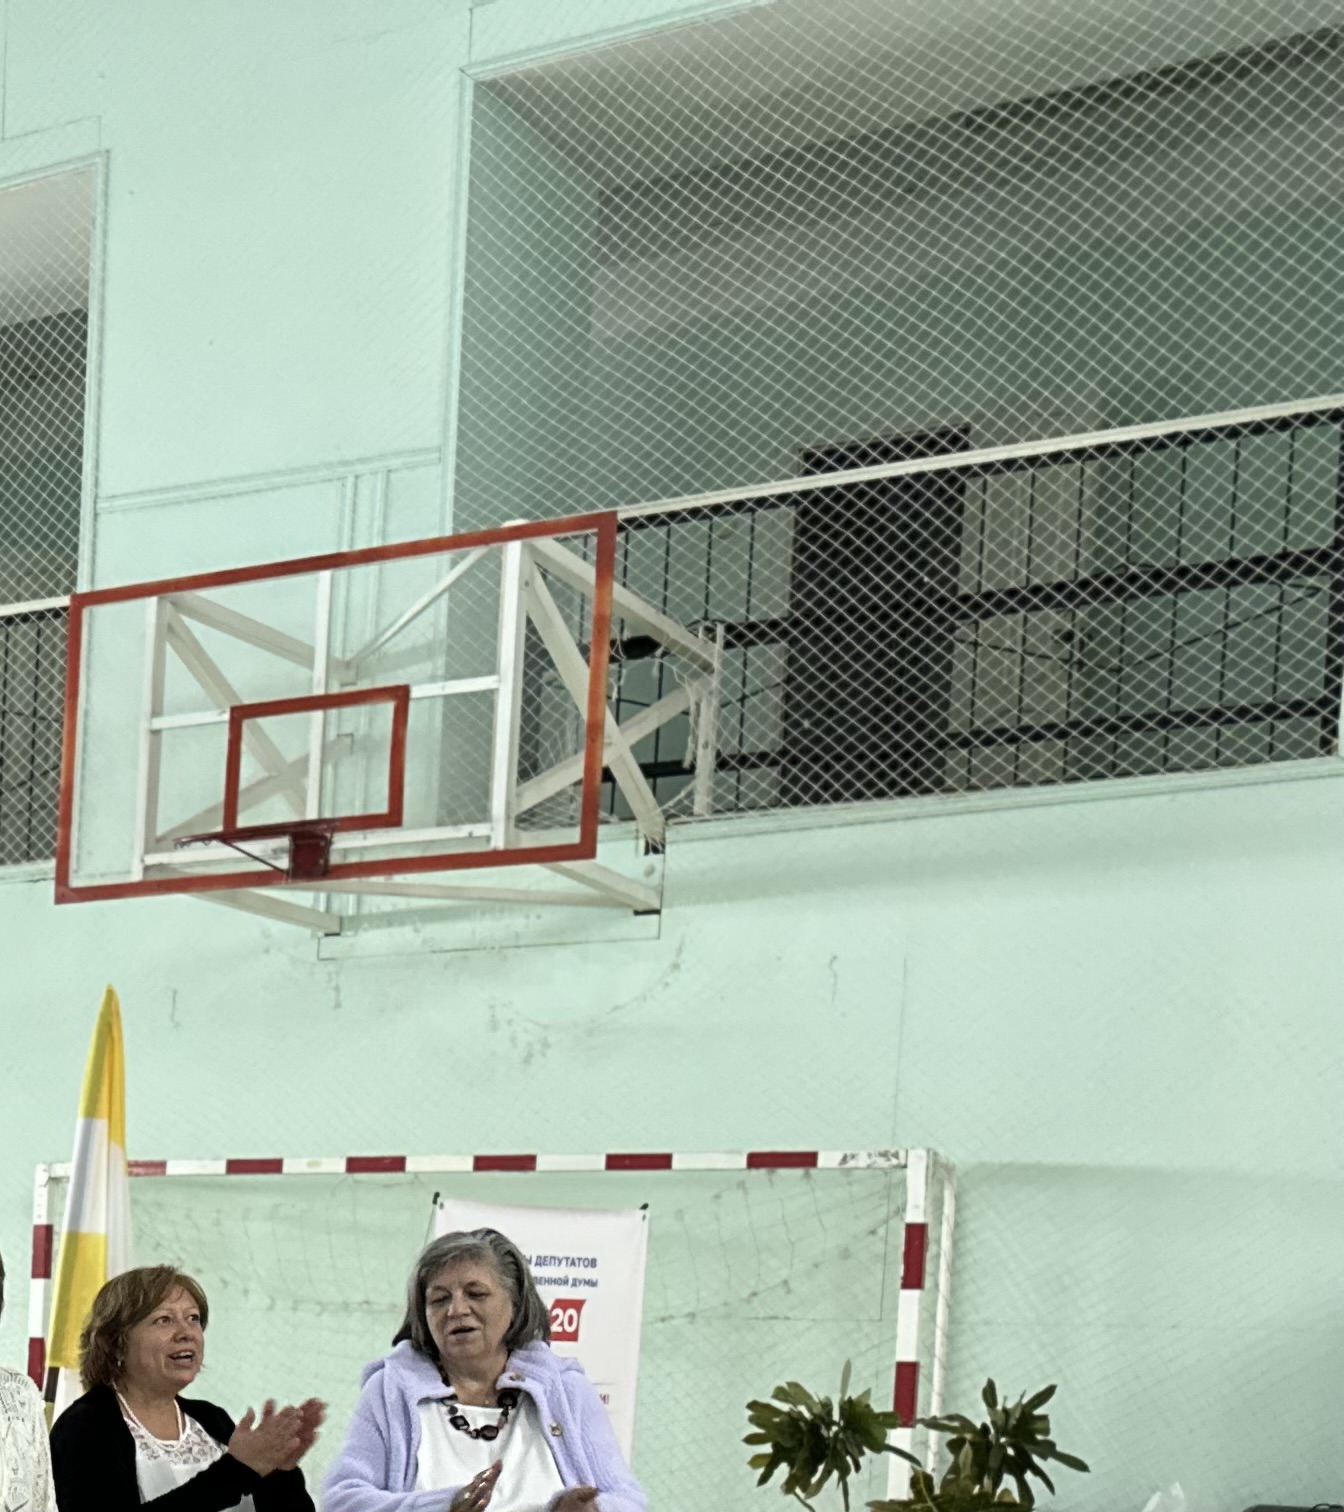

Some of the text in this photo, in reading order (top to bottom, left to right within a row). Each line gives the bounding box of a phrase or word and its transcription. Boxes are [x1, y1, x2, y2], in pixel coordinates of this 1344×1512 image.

[534, 1255, 598, 1269] ДЕПУТАТОВ
[571, 1277, 599, 1288] ДУМЫ
[550, 1307, 578, 1334] 20
